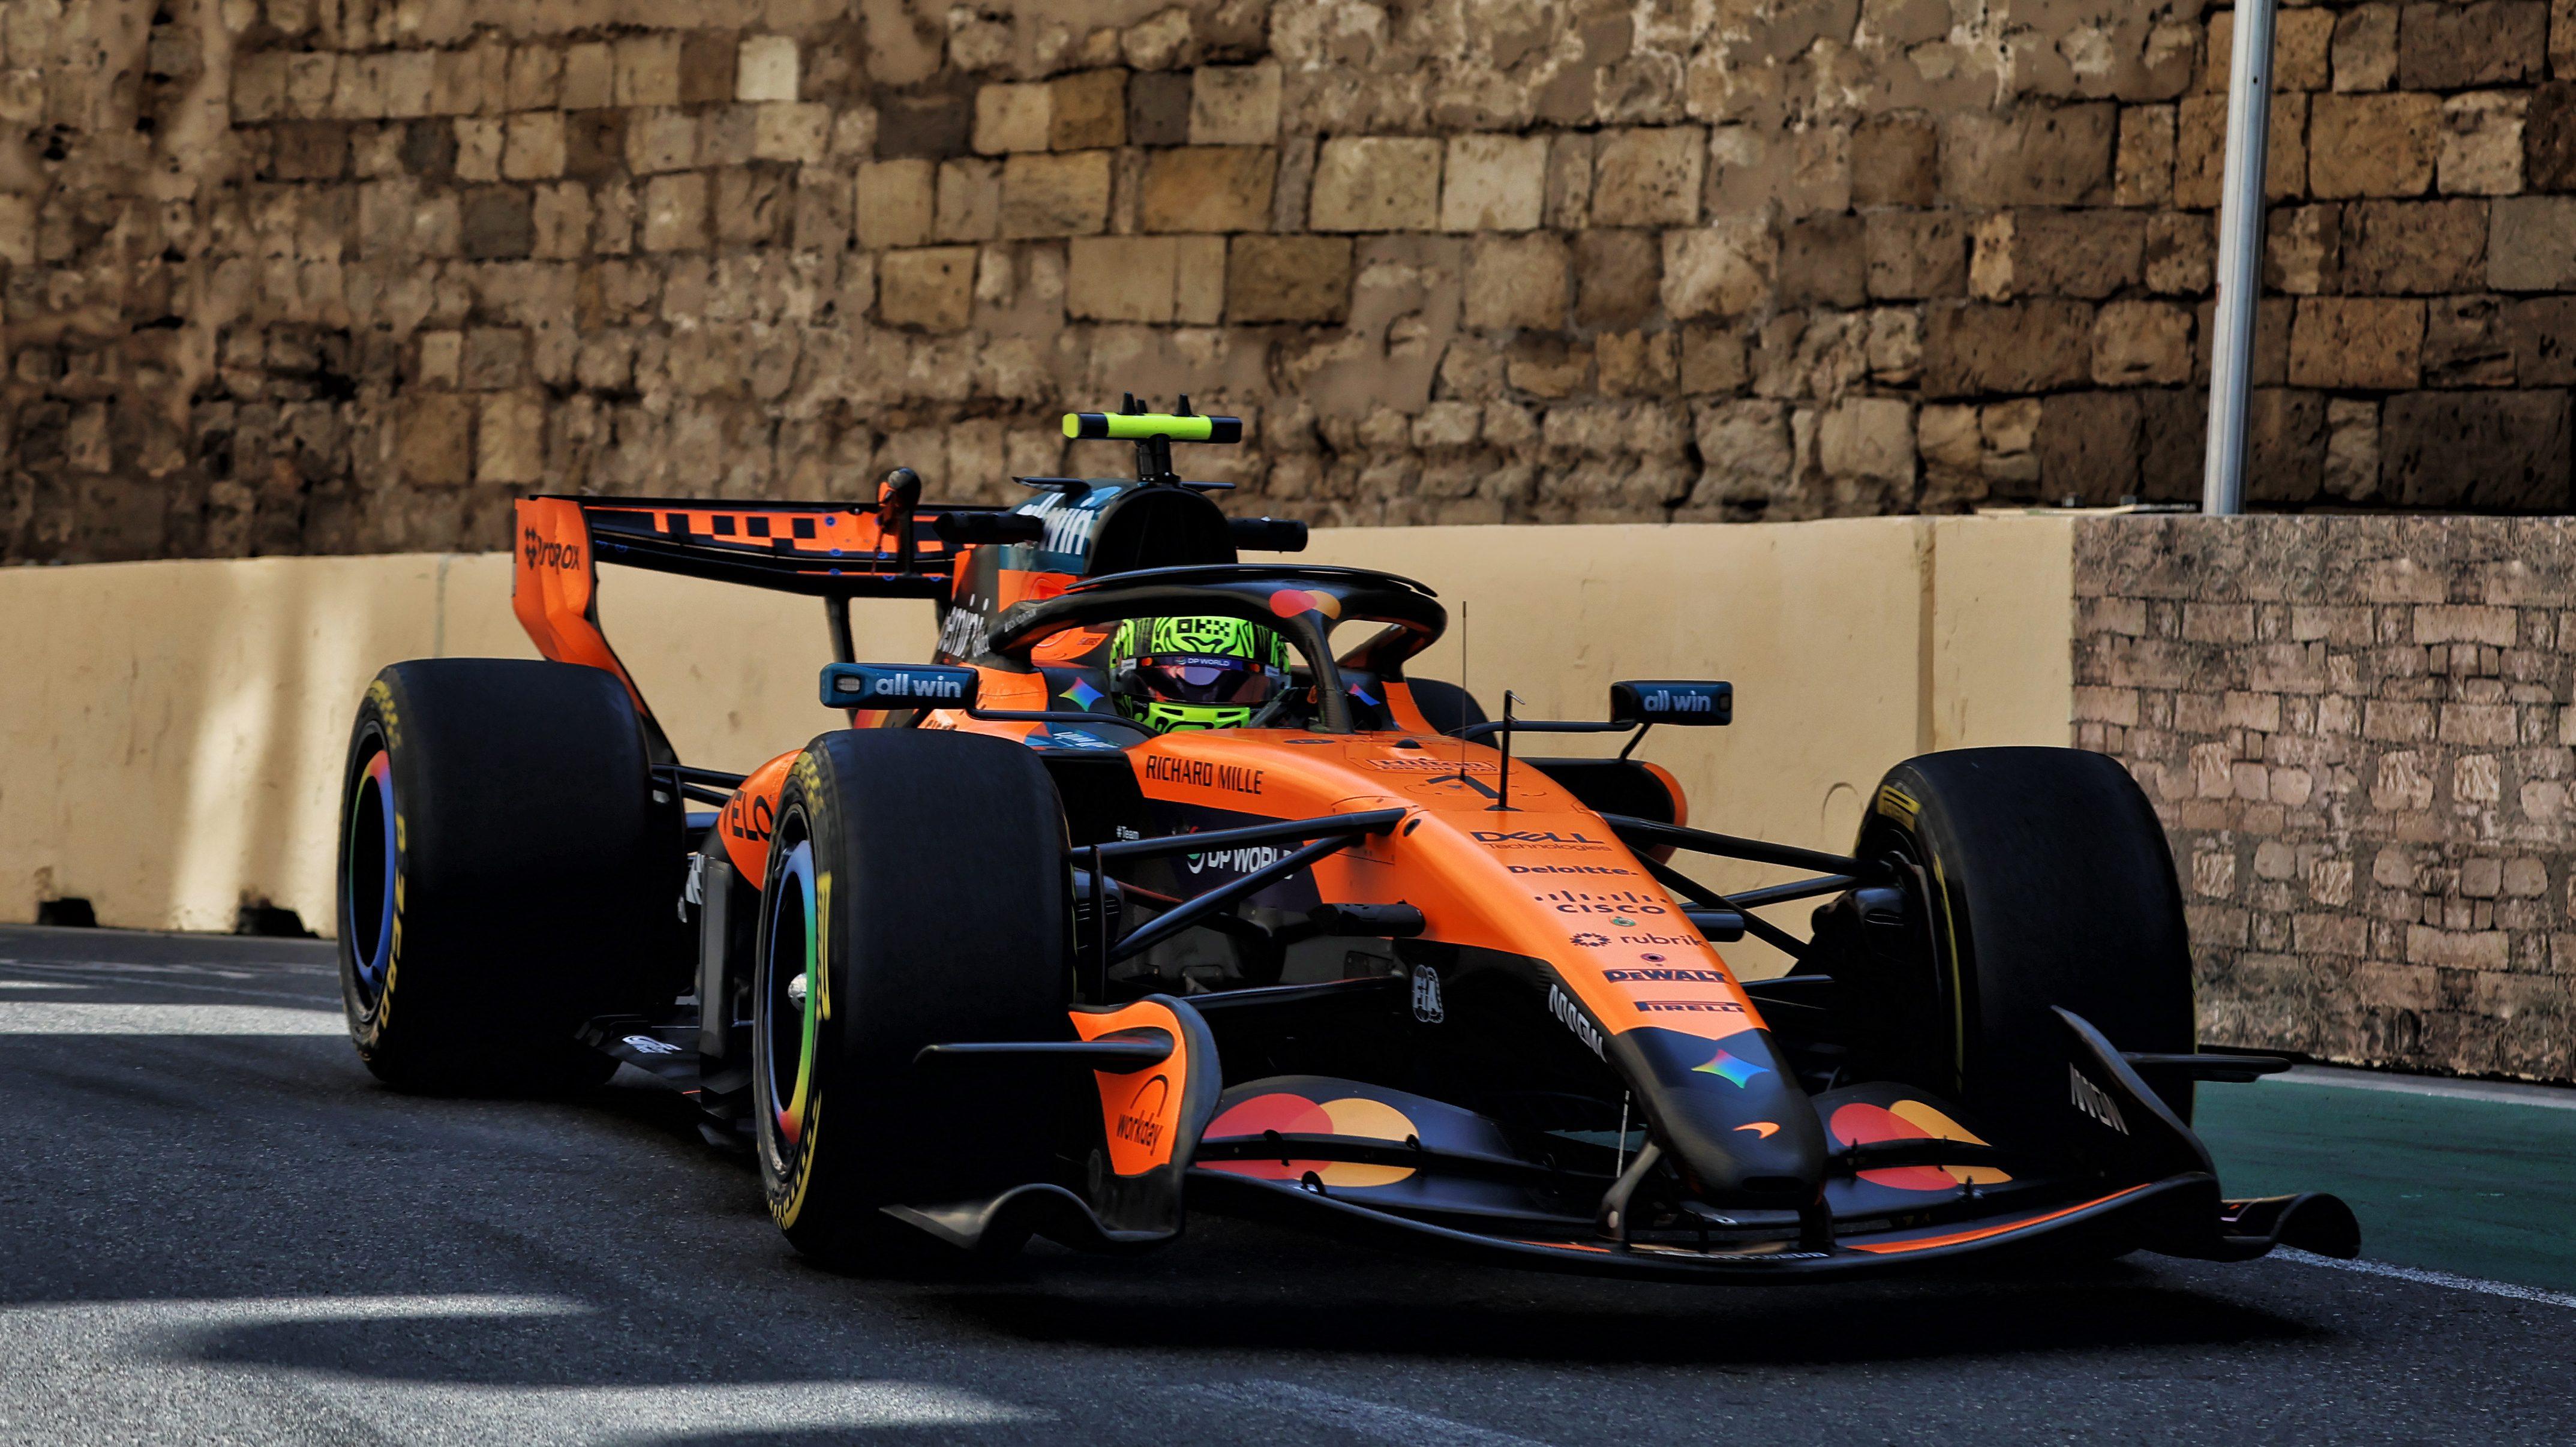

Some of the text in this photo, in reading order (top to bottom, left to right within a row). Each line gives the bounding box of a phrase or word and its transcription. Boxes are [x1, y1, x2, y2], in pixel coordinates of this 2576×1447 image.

[875, 673, 961, 698] all win
[1644, 690, 1711, 712] all win
[1146, 755, 1264, 795] RICHARD MILLE
[1469, 831, 1605, 844] DELL
[1484, 843, 1613, 851] Technologies
[1620, 933, 1708, 948] rubrik
[1633, 1001, 1746, 1013] PIRELLI
[1116, 1109, 1164, 1157] workday
